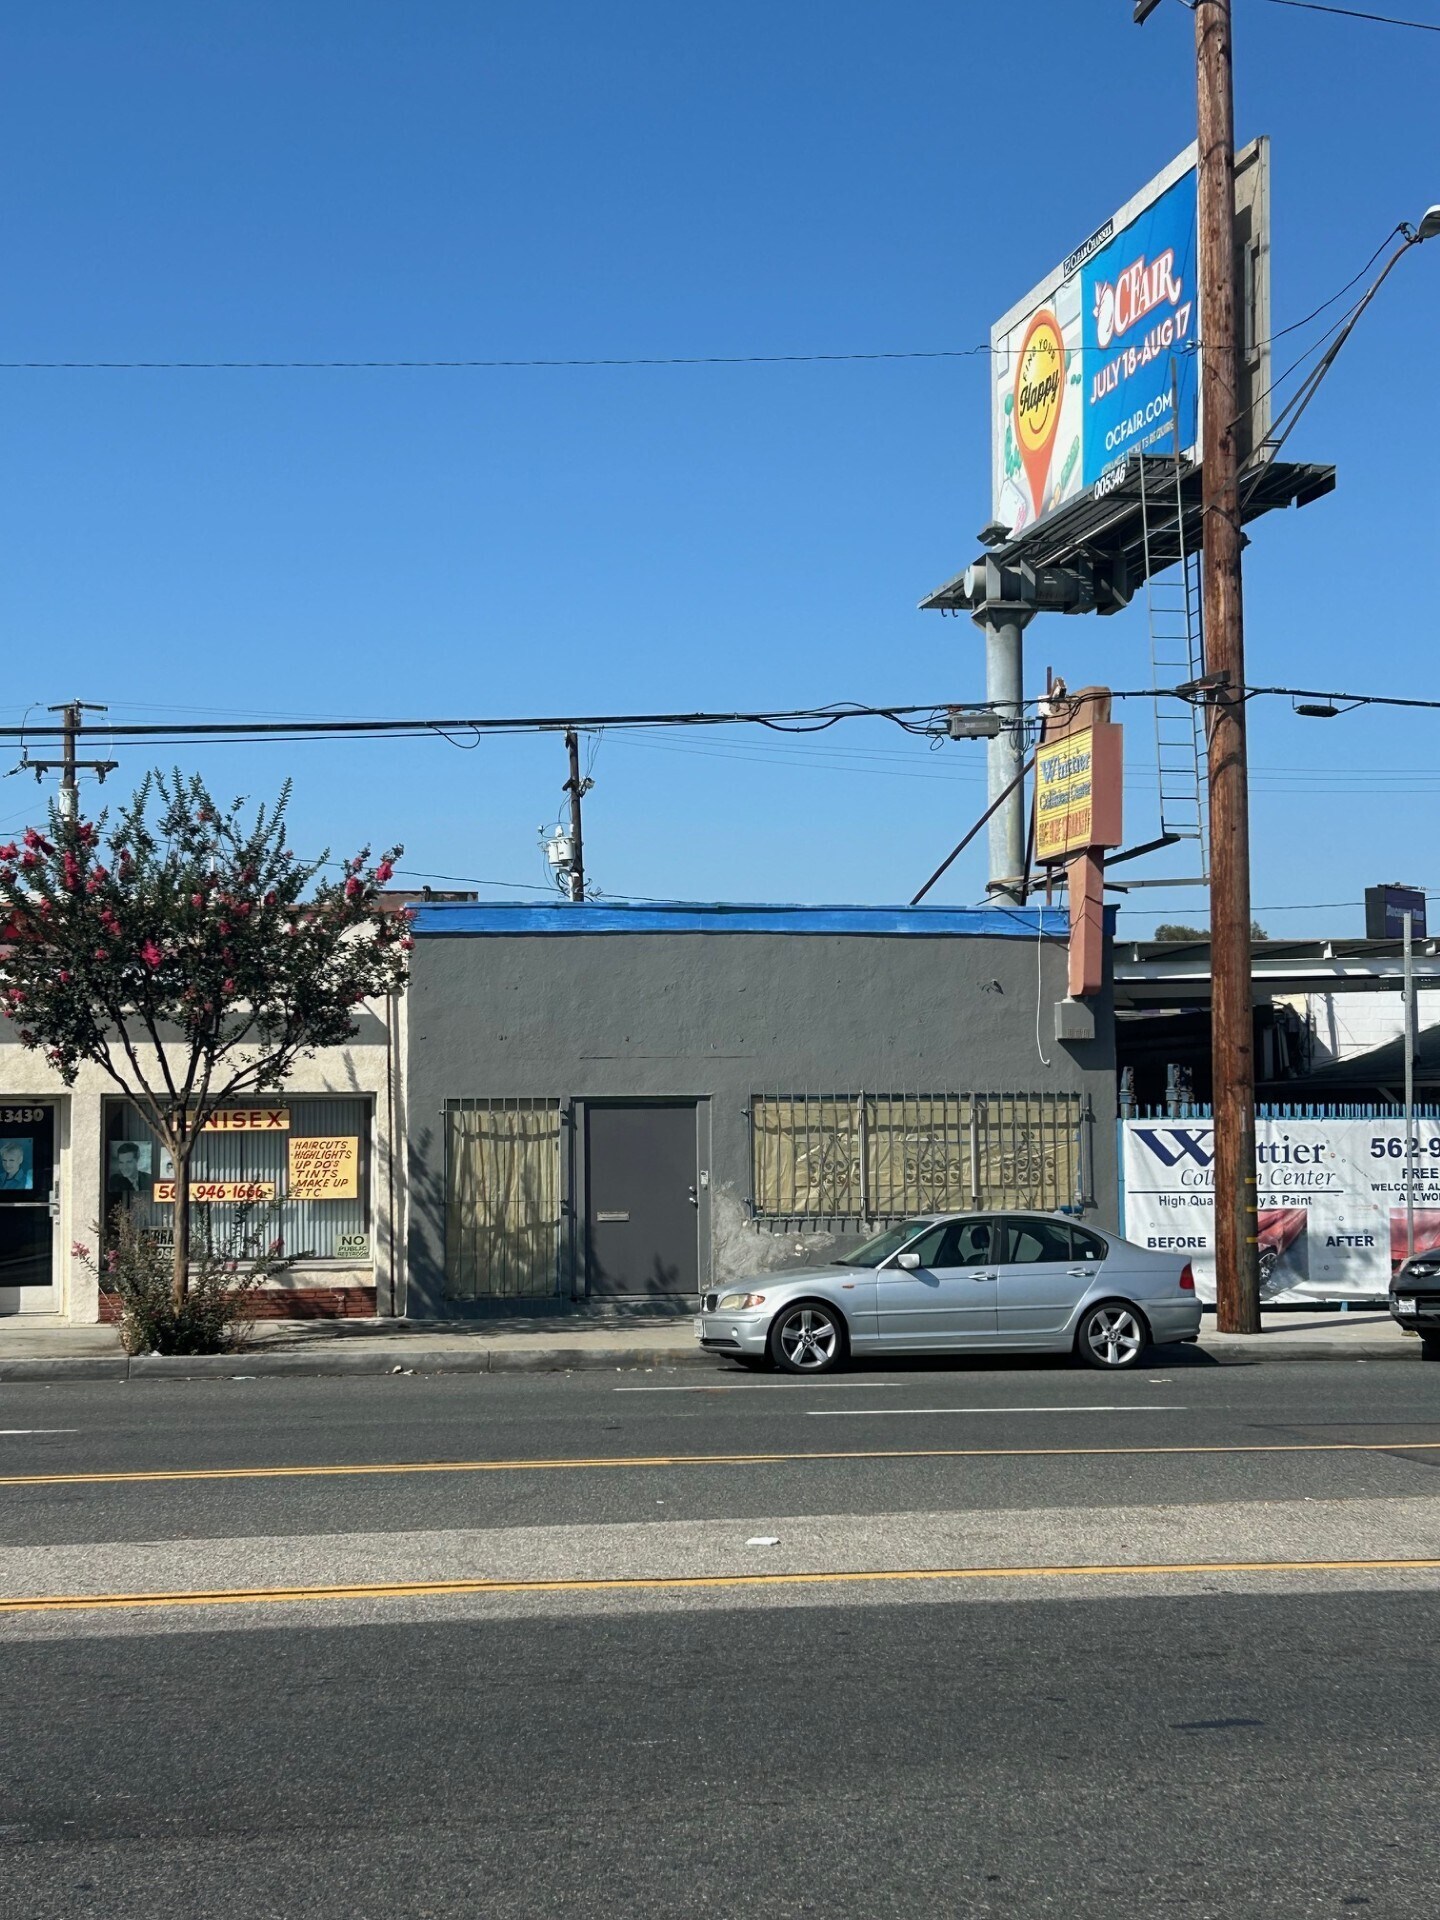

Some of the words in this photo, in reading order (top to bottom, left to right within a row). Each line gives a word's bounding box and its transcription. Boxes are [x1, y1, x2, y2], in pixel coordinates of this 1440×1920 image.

[1090, 356, 1121, 404] JULY
[1122, 318, 1173, 379] 18-AUG
[1175, 302, 1192, 340] 17
[1019, 368, 1060, 417] Happy
[1105, 387, 1173, 451] OCFAIR.COM
[178, 1110, 283, 1129] NISEX
[294, 1141, 349, 1150] HAIRCUTS
[1131, 1129, 1326, 1168] Wttier
[293, 1150, 352, 1160] HIGHLIGHTS
[295, 1160, 312, 1169] UP
[296, 1169, 339, 1178] TINTS
[1270, 1168, 1336, 1186] Center
[295, 1179, 330, 1188] MAKE
[333, 1178, 349, 1188] UP
[1159, 1194, 1186, 1208] High
[1270, 1195, 1278, 1206] &
[1282, 1194, 1313, 1206] Paint
[1399, 1192, 1419, 1201] AL
[341, 1235, 365, 1246] NO
[1147, 1236, 1207, 1248] BEFORE
[1326, 1235, 1375, 1248] AFTER
